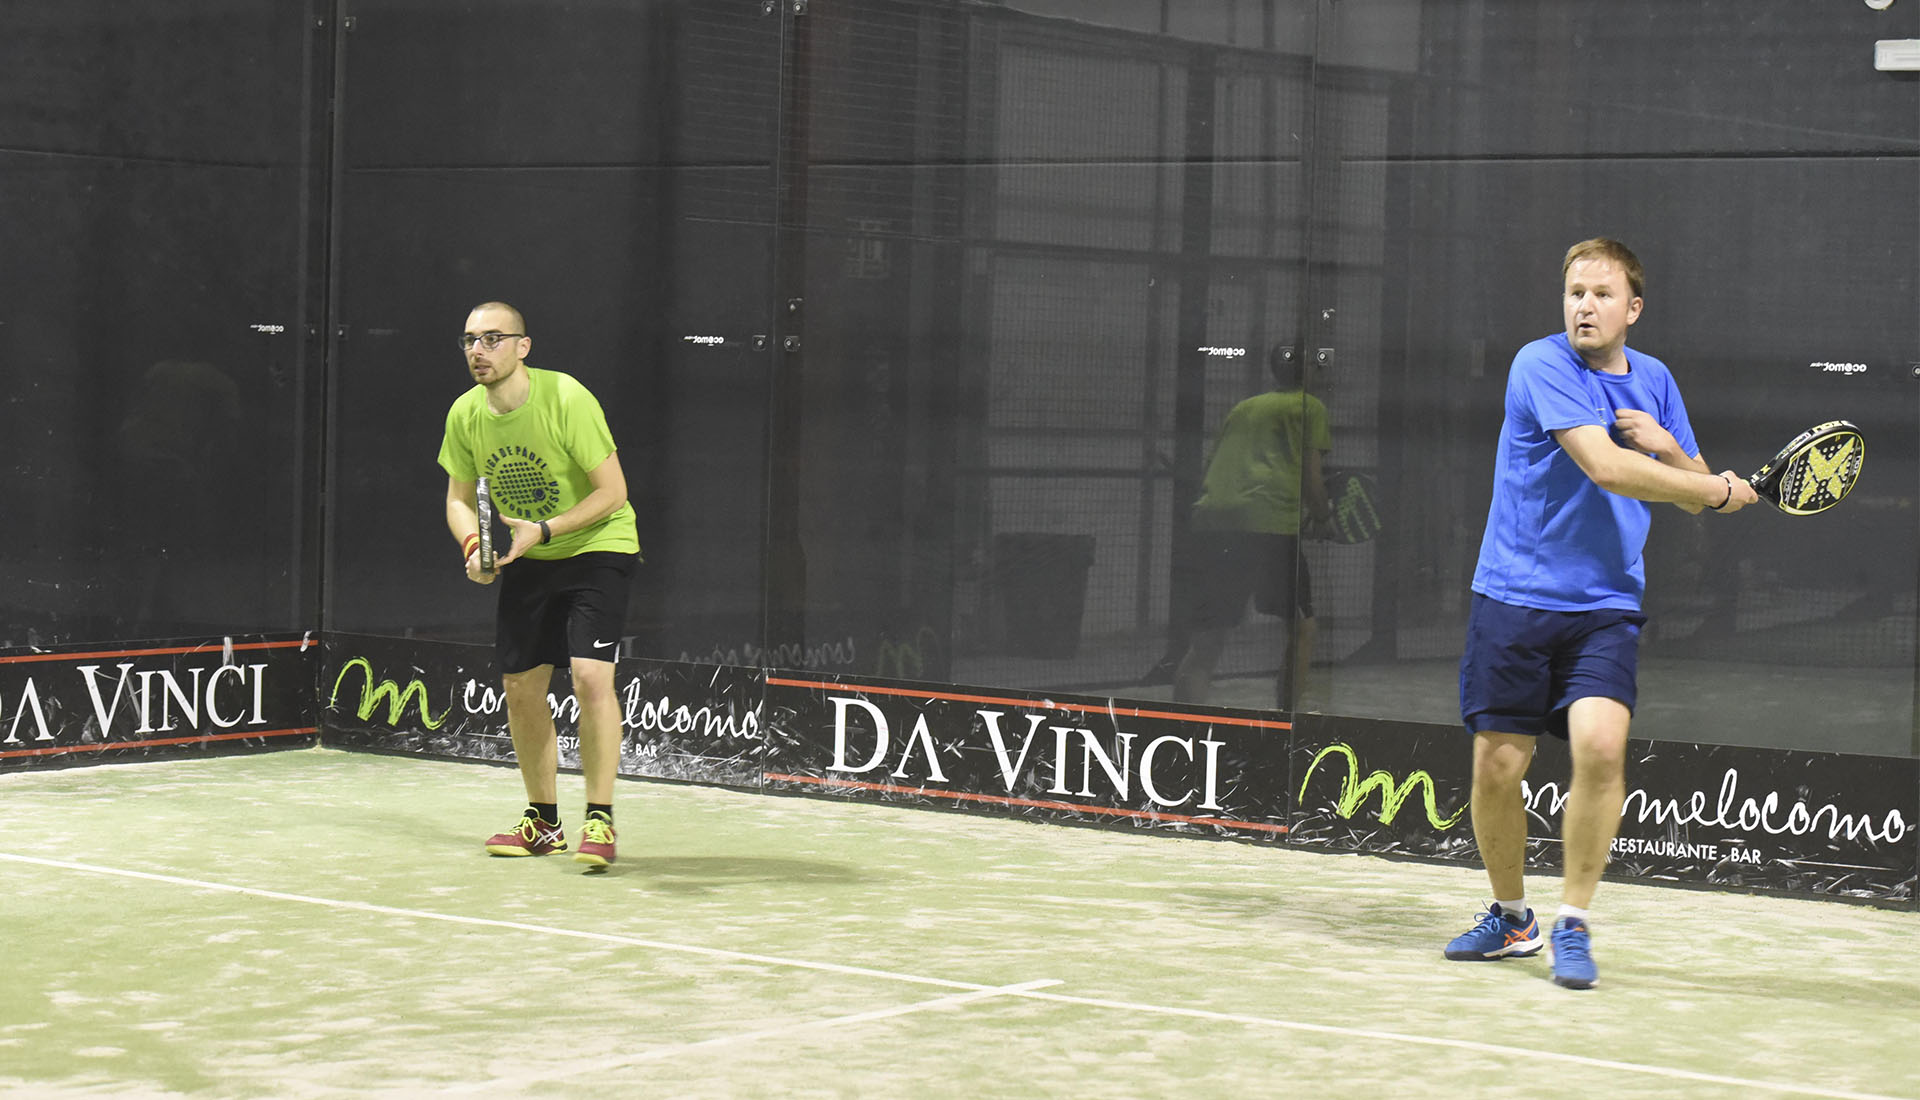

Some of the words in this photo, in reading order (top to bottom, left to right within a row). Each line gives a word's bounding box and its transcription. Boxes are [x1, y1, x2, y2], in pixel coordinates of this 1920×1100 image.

[499, 446, 513, 458] DE
[0, 676, 56, 743] A
[76, 663, 269, 739] VINCI
[635, 743, 658, 758] BAR
[826, 696, 950, 783] DA
[976, 709, 1226, 811] VINCI
[1609, 837, 1718, 861] RESTAURANTE
[1730, 847, 1762, 865] BAR
